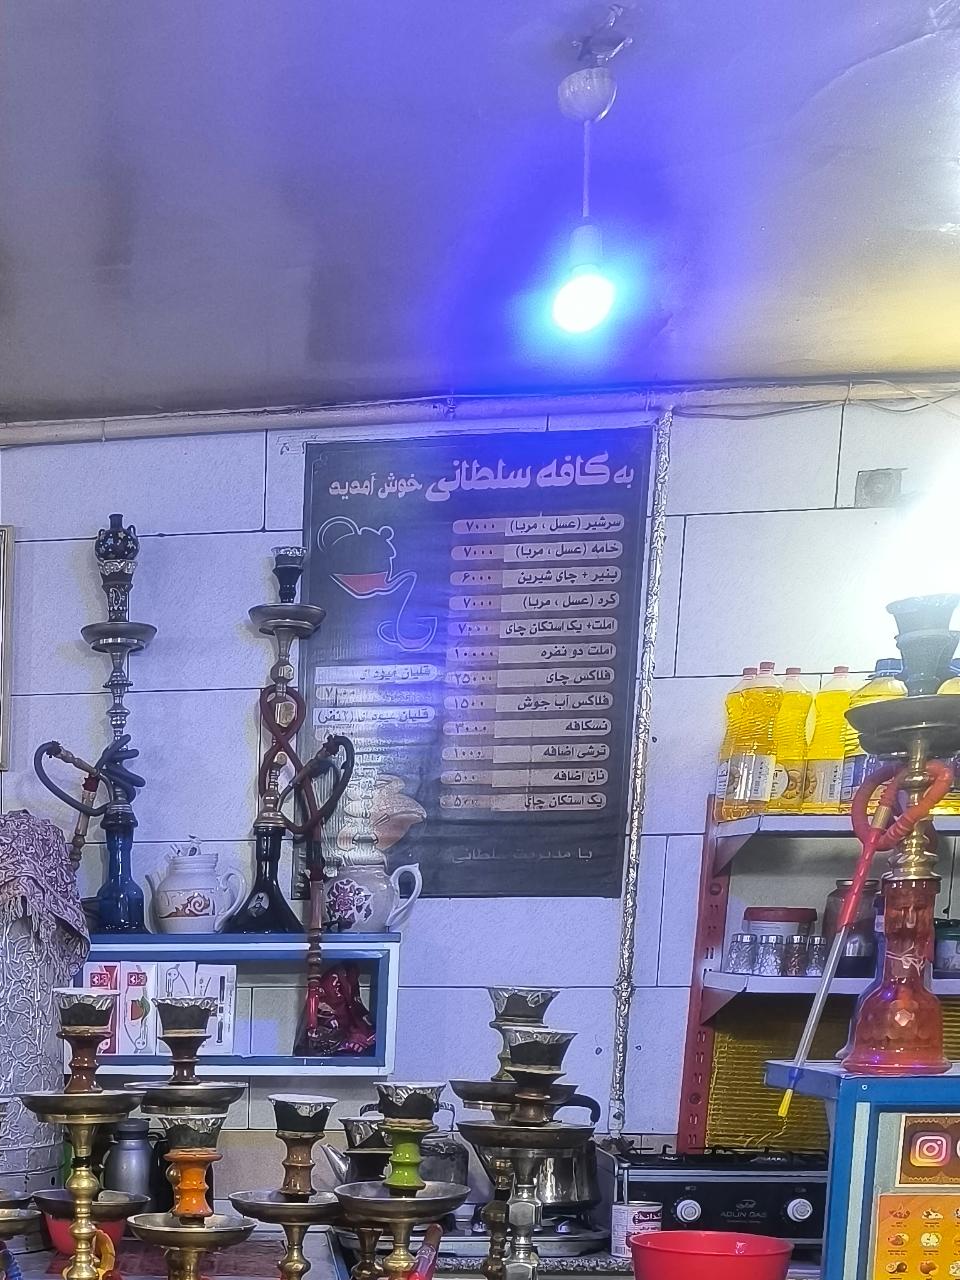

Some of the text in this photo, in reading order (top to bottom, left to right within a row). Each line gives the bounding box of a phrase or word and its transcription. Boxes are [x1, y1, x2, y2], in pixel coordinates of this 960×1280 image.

[329, 451, 634, 501] به کافه سلطانی خوش آمدید
[466, 521, 495, 531] ۷۰۰۰
[510, 519, 538, 532] مربا)
[550, 518, 580, 531] (عسل
[585, 516, 621, 530] سرشیر
[464, 547, 493, 556] ۷۰۰۰
[516, 545, 543, 558] مربا)
[556, 544, 586, 557] (عسل
[592, 543, 618, 554] خامه
[462, 573, 492, 582] ۶۰۰۰
[518, 571, 552, 584] شیرین
[556, 570, 577, 583] چای
[591, 569, 617, 583] پنیر
[464, 598, 492, 608] ۷۰۰۰
[524, 596, 550, 609] مربا)
[563, 594, 593, 607] (عسل
[506, 623, 526, 636] چای
[530, 621, 564, 634] استکان
[567, 620, 582, 633] یک
[455, 645, 612, 658] املت دو نفره ۱۰۰۰۰
[546, 673, 569, 685] چای
[573, 672, 610, 683] فلاکس
[455, 695, 609, 710] فلاکس آب جوش ۱۵۰۰
[456, 721, 607, 731] نسکافه ۳۰۰۰
[543, 746, 574, 756] اضافه
[577, 747, 606, 758] ترشی
[455, 771, 604, 783] نان اضافه ۵۰۰
[524, 798, 545, 808] چای
[548, 795, 584, 808] استکان
[587, 795, 602, 804] یک
